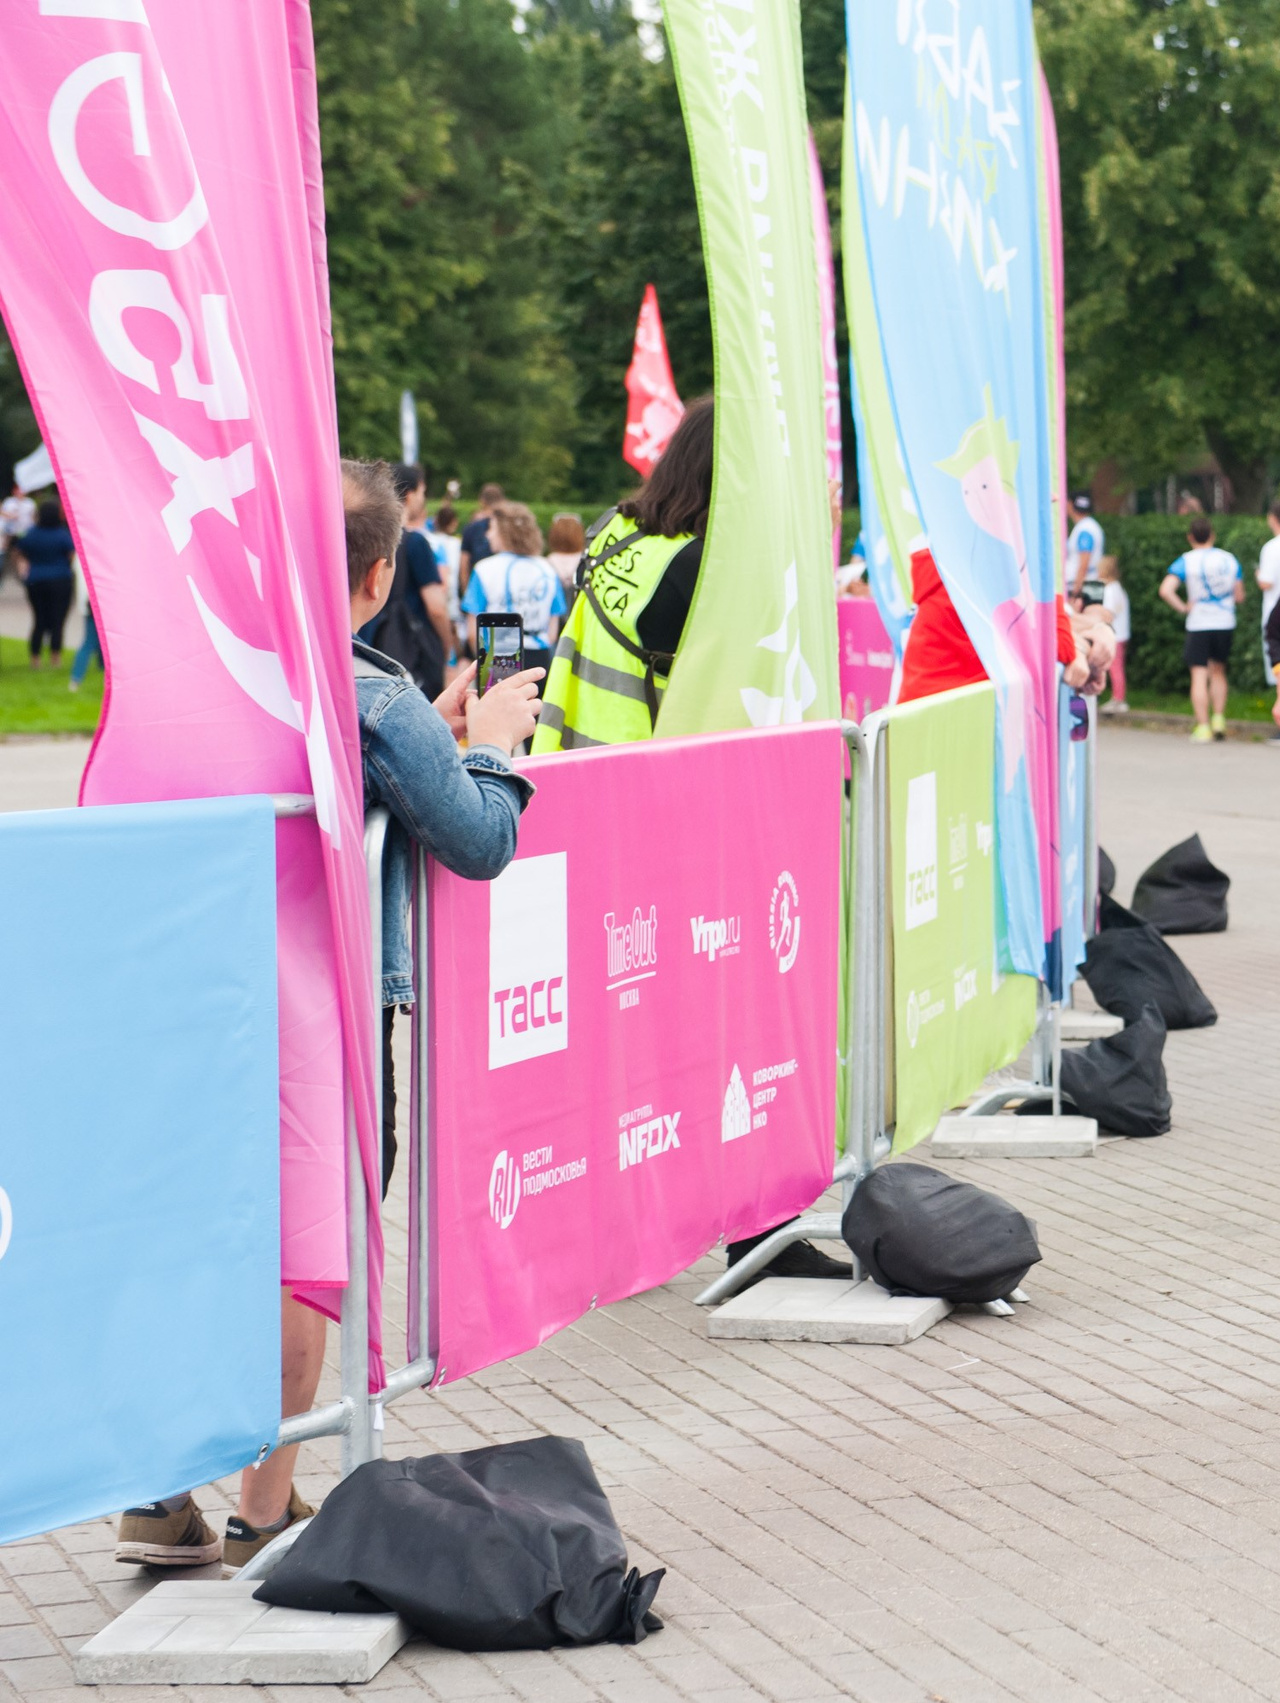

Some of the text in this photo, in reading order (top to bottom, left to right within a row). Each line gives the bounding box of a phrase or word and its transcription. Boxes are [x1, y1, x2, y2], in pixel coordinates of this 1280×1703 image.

[752, 1086, 777, 1110] ЦЕНТР
[618, 1111, 682, 1172] INFOX
[522, 1156, 587, 1197] ПОДМОСКОВЬЯ
